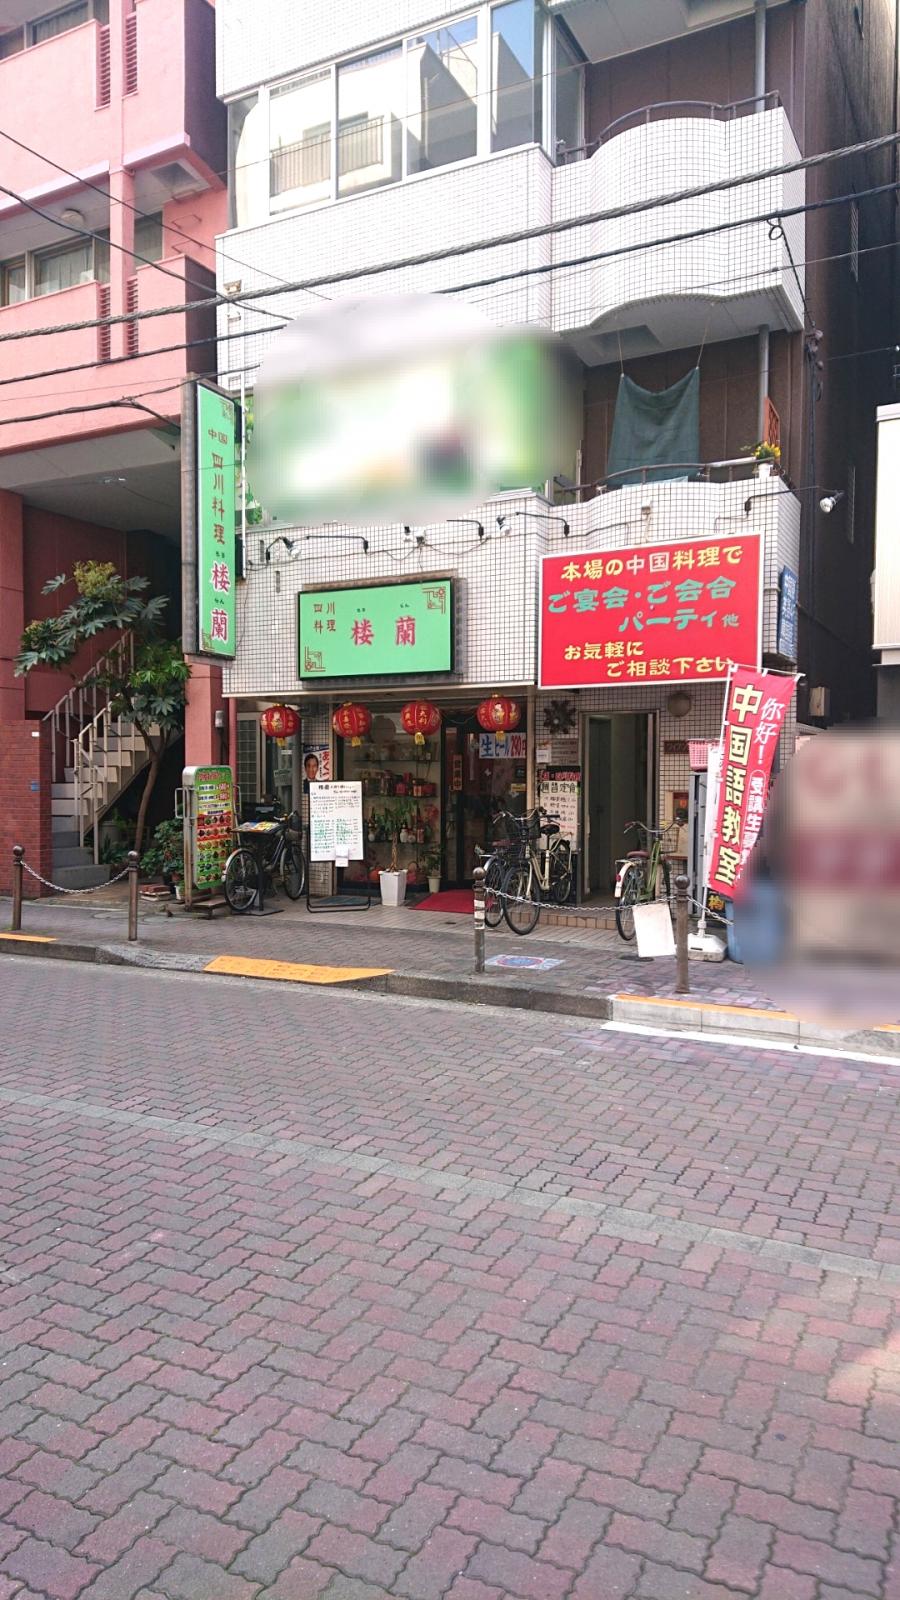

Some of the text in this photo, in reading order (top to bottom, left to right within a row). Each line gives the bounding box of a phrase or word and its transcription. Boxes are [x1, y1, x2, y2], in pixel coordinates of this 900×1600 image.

[208, 429, 228, 444] 中国
[211, 453, 226, 545] 四川料理
[561, 546, 743, 582] 本場の中国料理で
[210, 561, 231, 644] 楼蘭
[313, 601, 336, 615] 四川
[548, 575, 737, 613] ご宴会・ご会合
[313, 619, 336, 634] 料理
[350, 615, 416, 646] 楼蘭
[564, 641, 645, 660] お気軽に
[606, 656, 733, 678] ご相談下さい
[714, 684, 764, 887] 中国語教室
